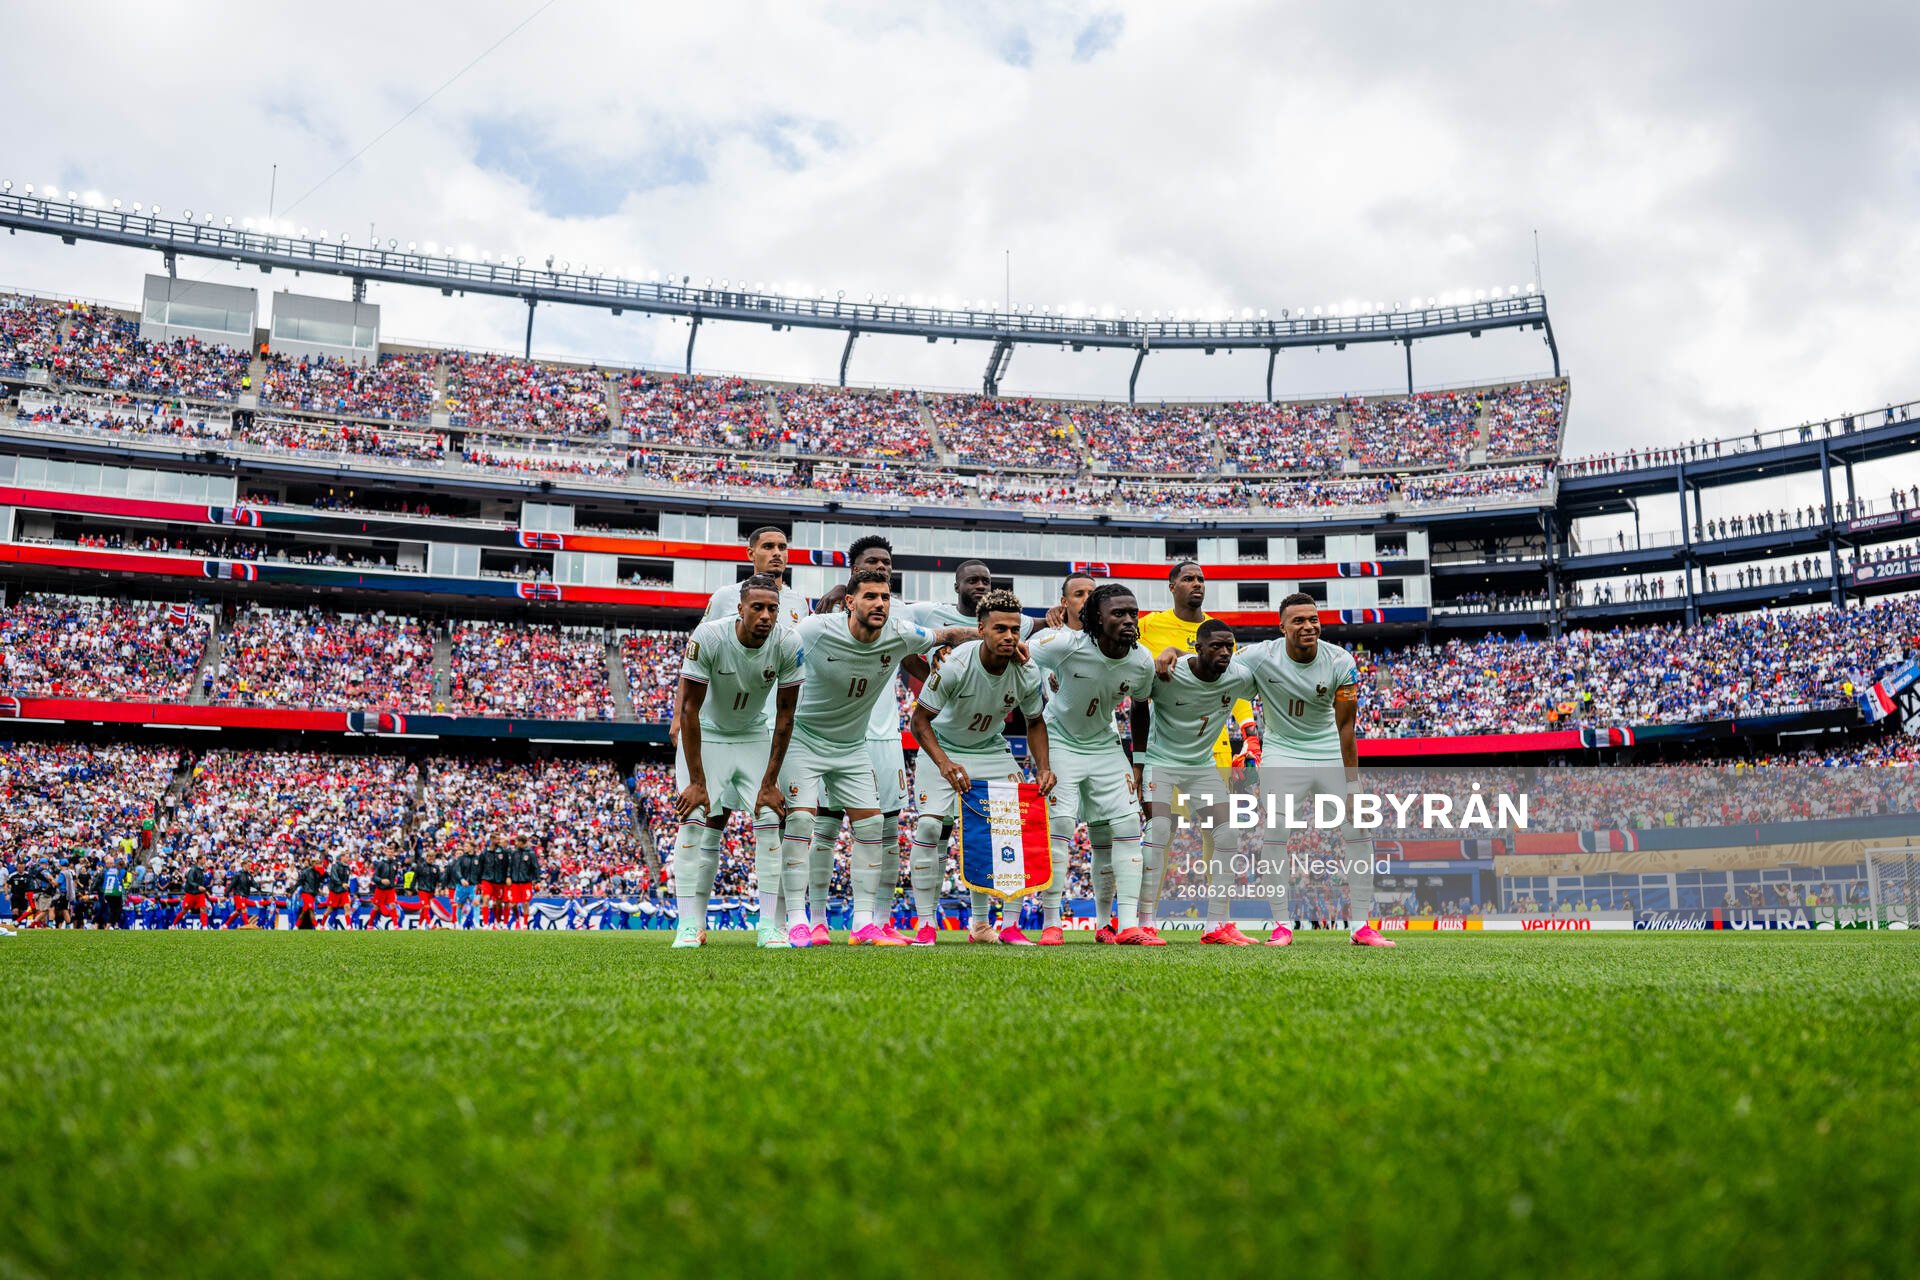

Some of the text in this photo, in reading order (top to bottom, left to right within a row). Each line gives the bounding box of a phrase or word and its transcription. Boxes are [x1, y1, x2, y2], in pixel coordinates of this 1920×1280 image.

[1860, 517, 1879, 528] 2007
[1876, 561, 1907, 578] 2021
[847, 677, 868, 698] 19
[733, 692, 750, 710] 11
[1086, 698, 1099, 717] 6
[1288, 698, 1305, 717] 10
[1739, 703, 1810, 718] AVEC TOI DIDIER
[967, 712, 993, 732] 20
[1197, 715, 1209, 737] 7
[991, 828, 1022, 837] FRANCE
[1520, 913, 1591, 931] verizon
[1635, 908, 1811, 930] Michelob ULTRA
